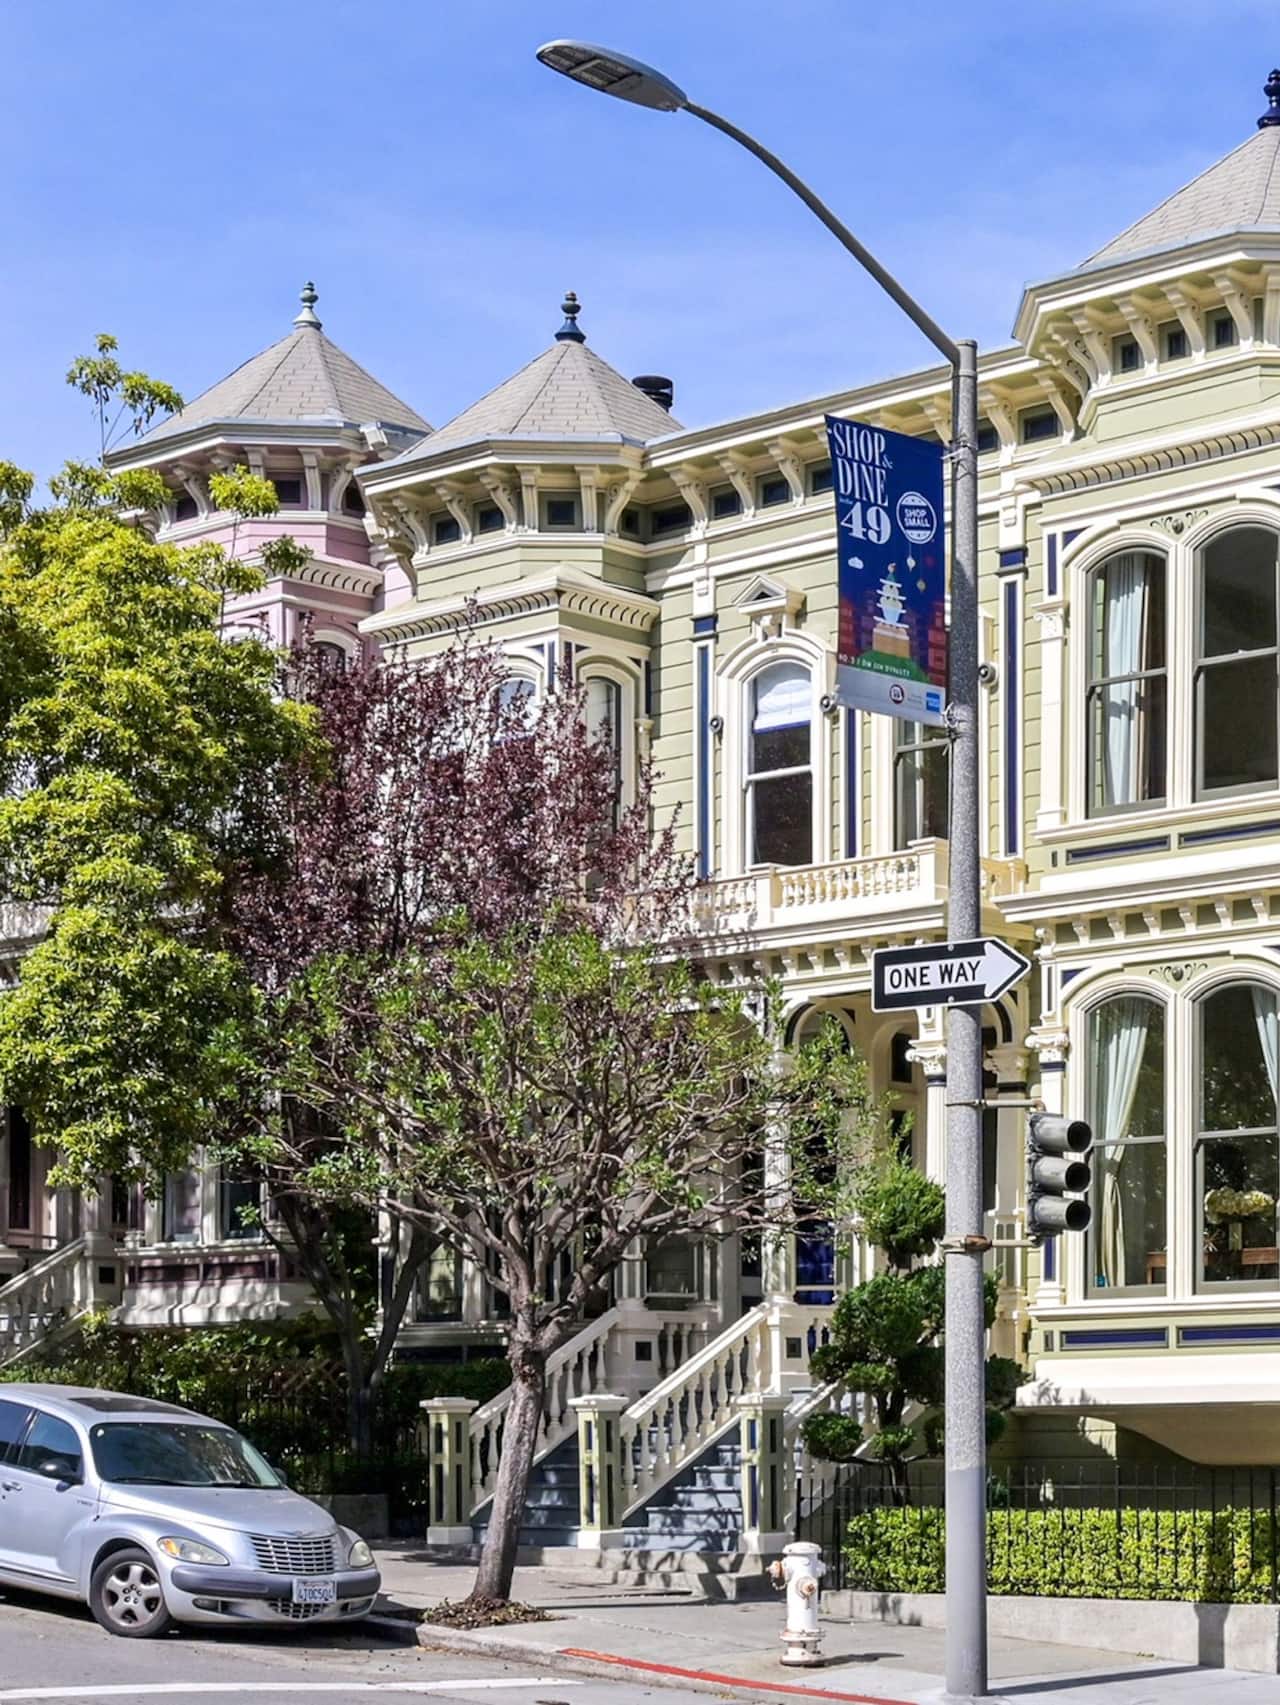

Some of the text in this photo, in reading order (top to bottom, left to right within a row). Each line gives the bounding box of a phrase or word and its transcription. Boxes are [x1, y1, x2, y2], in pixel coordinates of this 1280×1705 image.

[833, 422, 885, 466] SHOP
[837, 457, 888, 507] DINE
[840, 501, 892, 545] 49
[903, 517, 931, 528] SMALL
[904, 508, 927, 517] SHOP
[890, 960, 980, 989] ONE WAY
